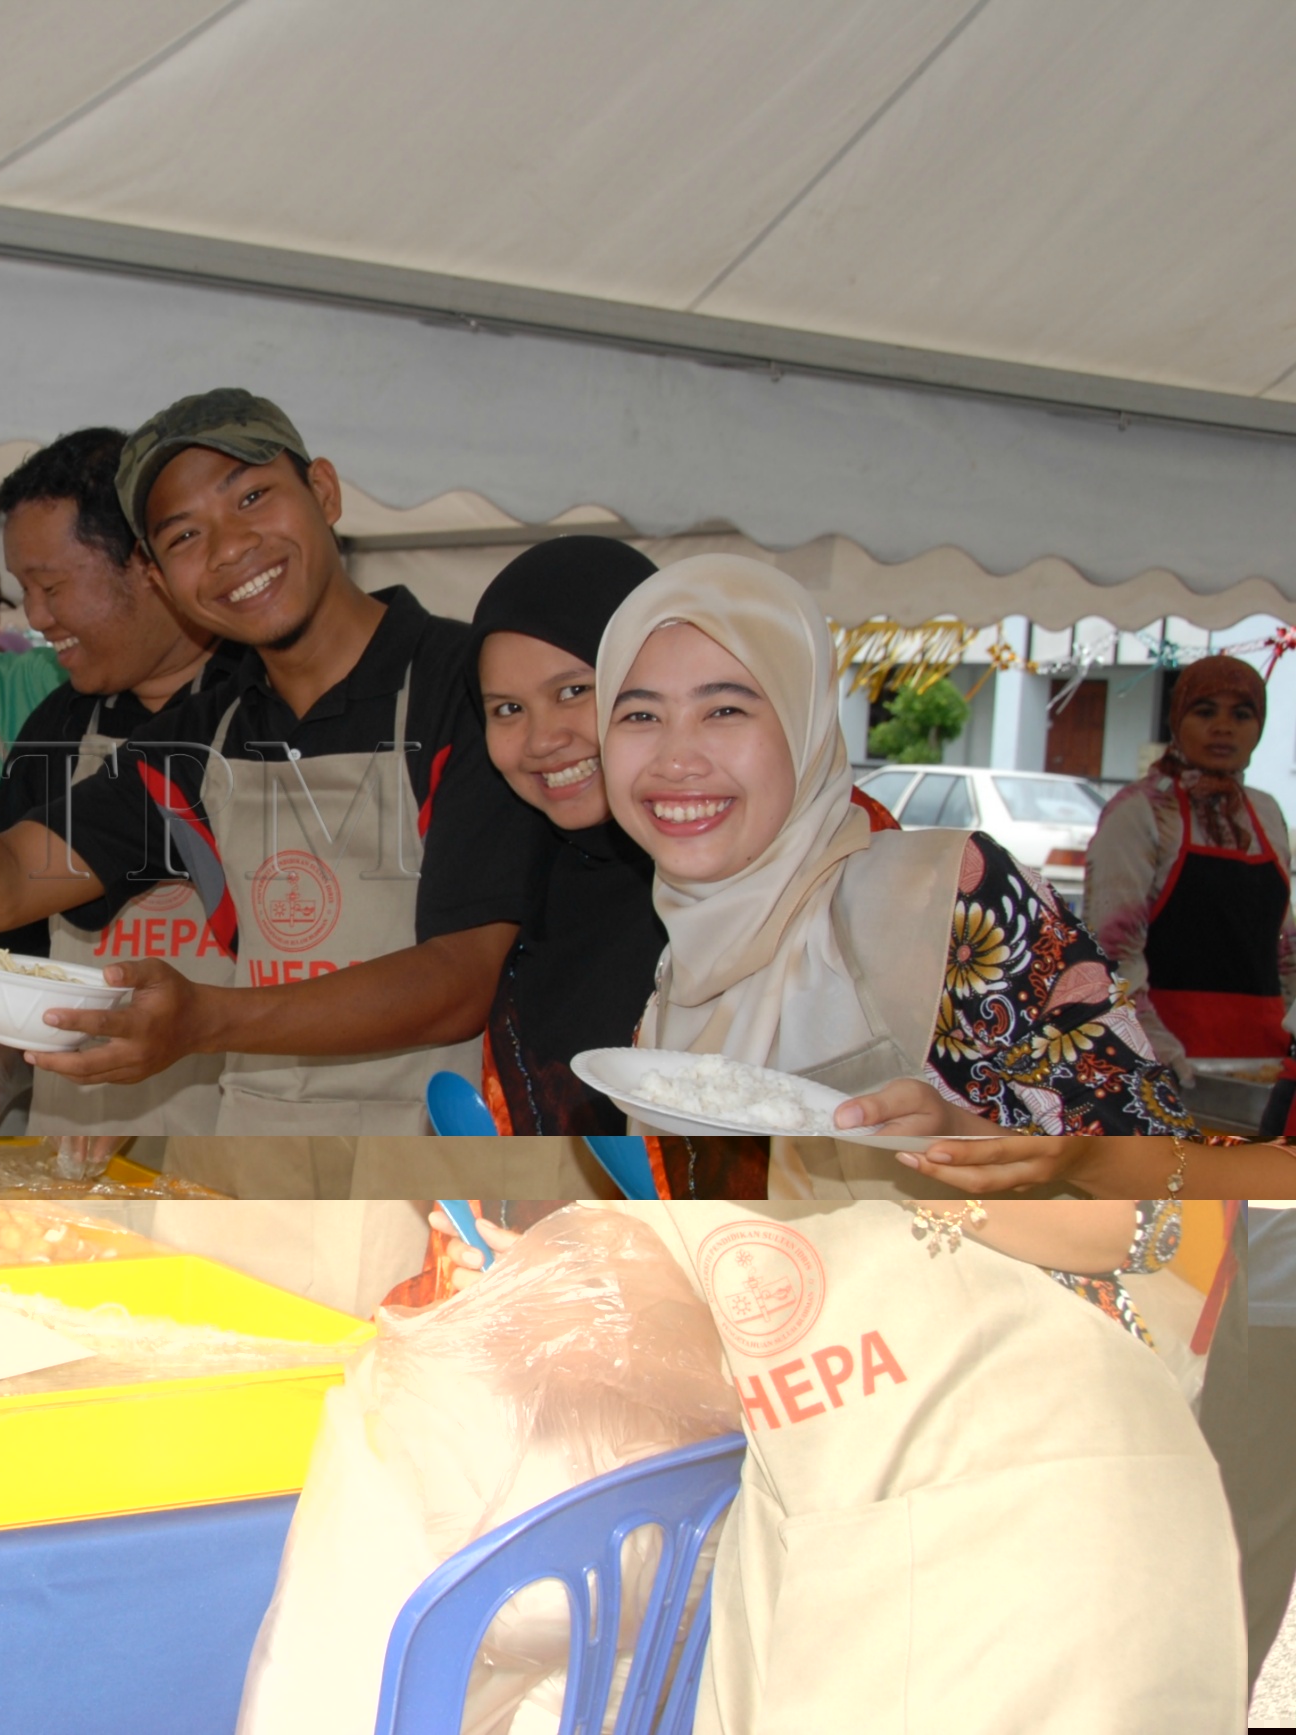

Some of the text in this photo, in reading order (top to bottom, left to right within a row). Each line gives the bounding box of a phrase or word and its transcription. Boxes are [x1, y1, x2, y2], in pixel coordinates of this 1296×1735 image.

[93, 918, 228, 957] JHEPA
[762, 1231, 796, 1250] SULTAN
[734, 1330, 907, 1431] HEPA
